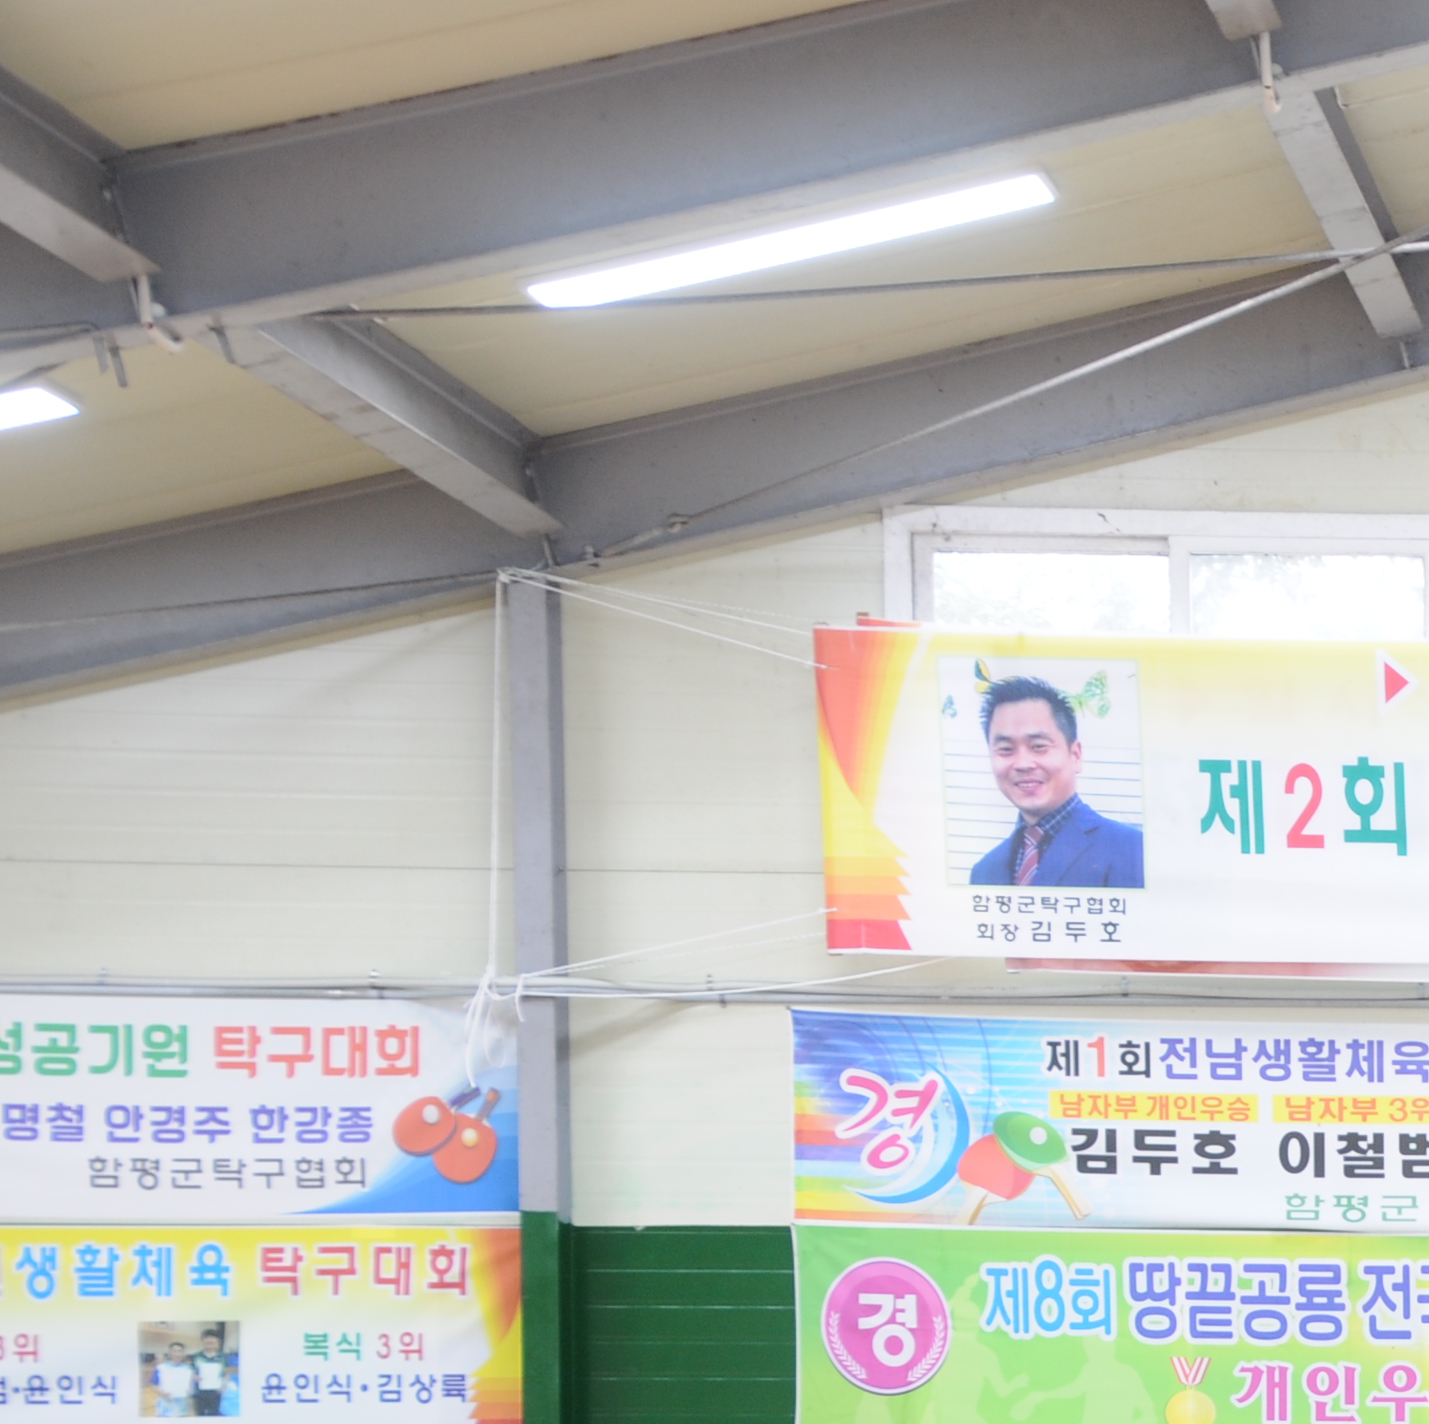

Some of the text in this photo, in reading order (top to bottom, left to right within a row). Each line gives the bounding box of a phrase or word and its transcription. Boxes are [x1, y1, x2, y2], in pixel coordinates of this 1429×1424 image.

[1199, 755, 1408, 858] 제2회
[971, 894, 1128, 916] 함평군탁구협회
[975, 919, 1123, 944] 회장 김두호
[0, 1022, 421, 1079] 성공기원 탁구대회
[1, 1103, 375, 1144] 명철 안경주 한강종
[838, 1071, 938, 1170] 경
[1059, 1093, 1252, 1122] 남자부 개인우승
[1284, 1096, 1379, 1123] 남자부
[1069, 1127, 1240, 1176] 김두호
[87, 1156, 368, 1191] 함평군탁구협회
[1284, 1192, 1420, 1223] 함평군
[15, 1242, 469, 1299] 생활체육 탁구대회
[982, 1259, 1113, 1337] 제8회
[1128, 1261, 1345, 1341] 땅끝공룡
[303, 1332, 363, 1362] 복식
[857, 1292, 918, 1367] 경
